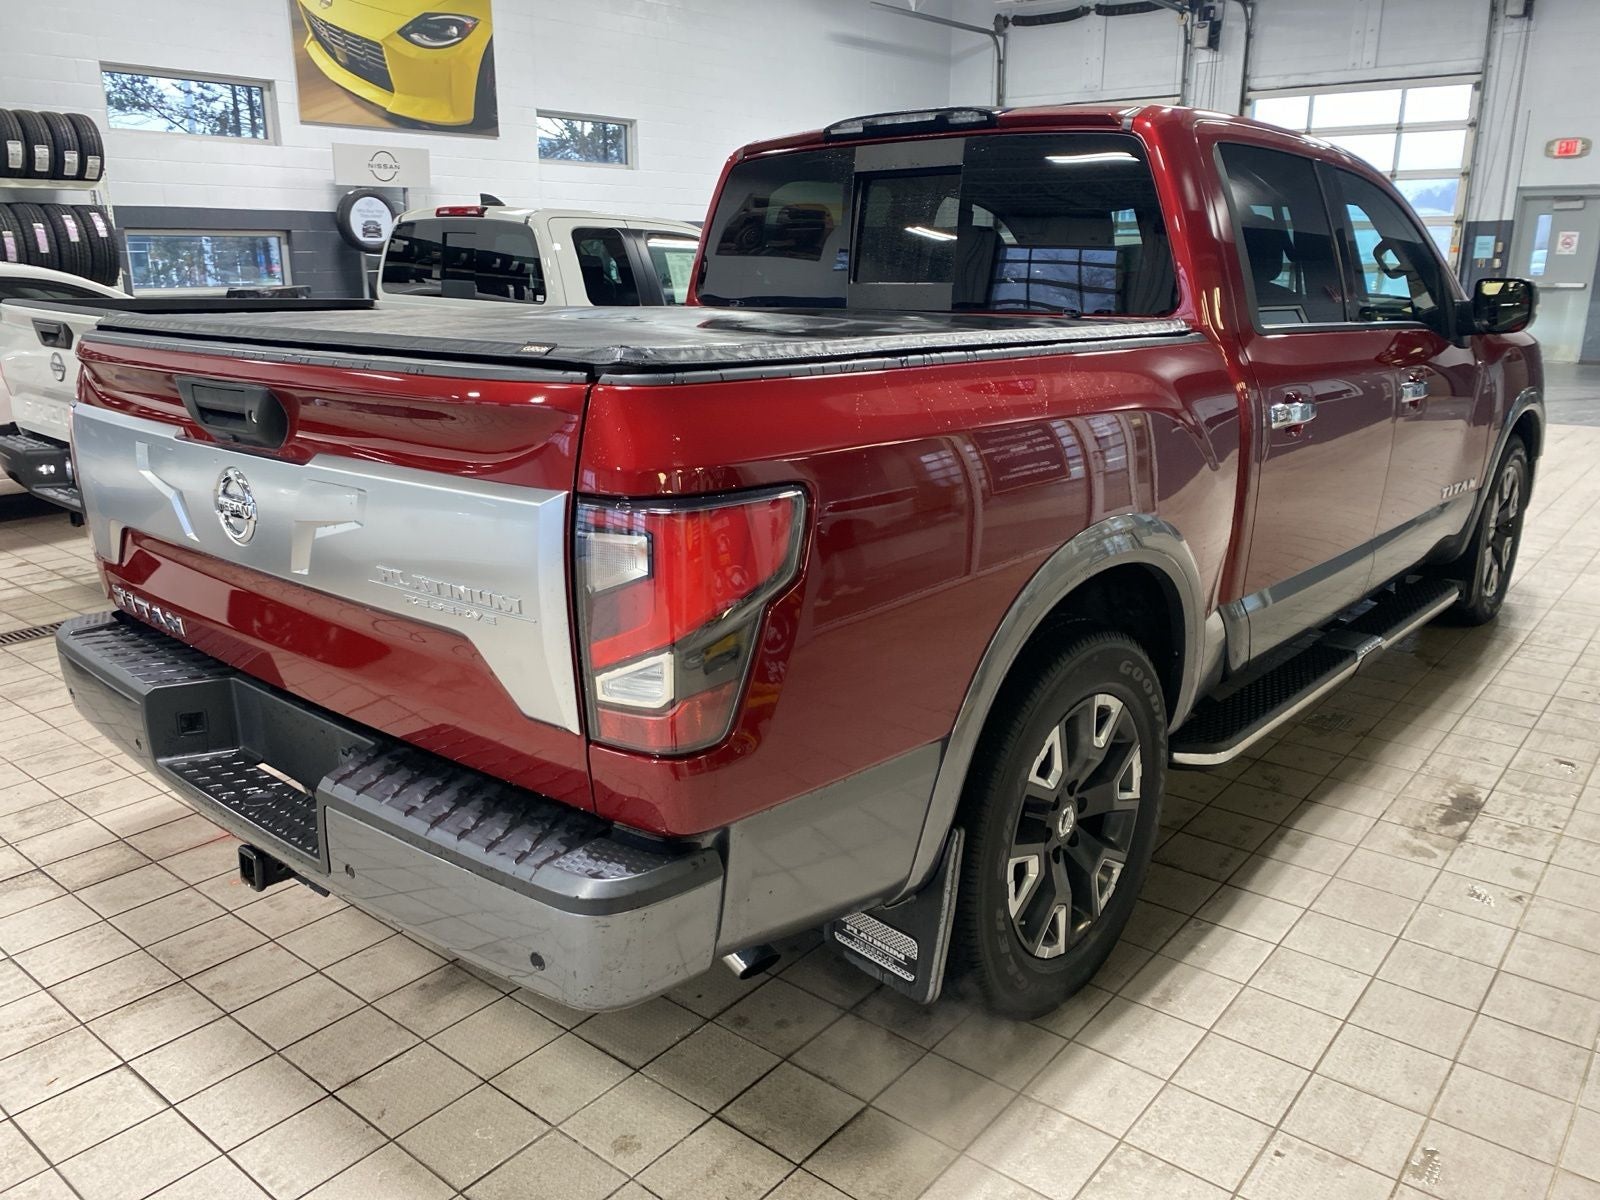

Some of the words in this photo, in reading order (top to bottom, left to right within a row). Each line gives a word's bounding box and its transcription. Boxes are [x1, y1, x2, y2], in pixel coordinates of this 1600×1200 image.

[367, 162, 400, 170] NISSAN
[1440, 476, 1477, 499] TITAN
[376, 564, 523, 615] PLATINUM
[111, 584, 187, 638] TITAN
[846, 924, 906, 961] PLATINUM
